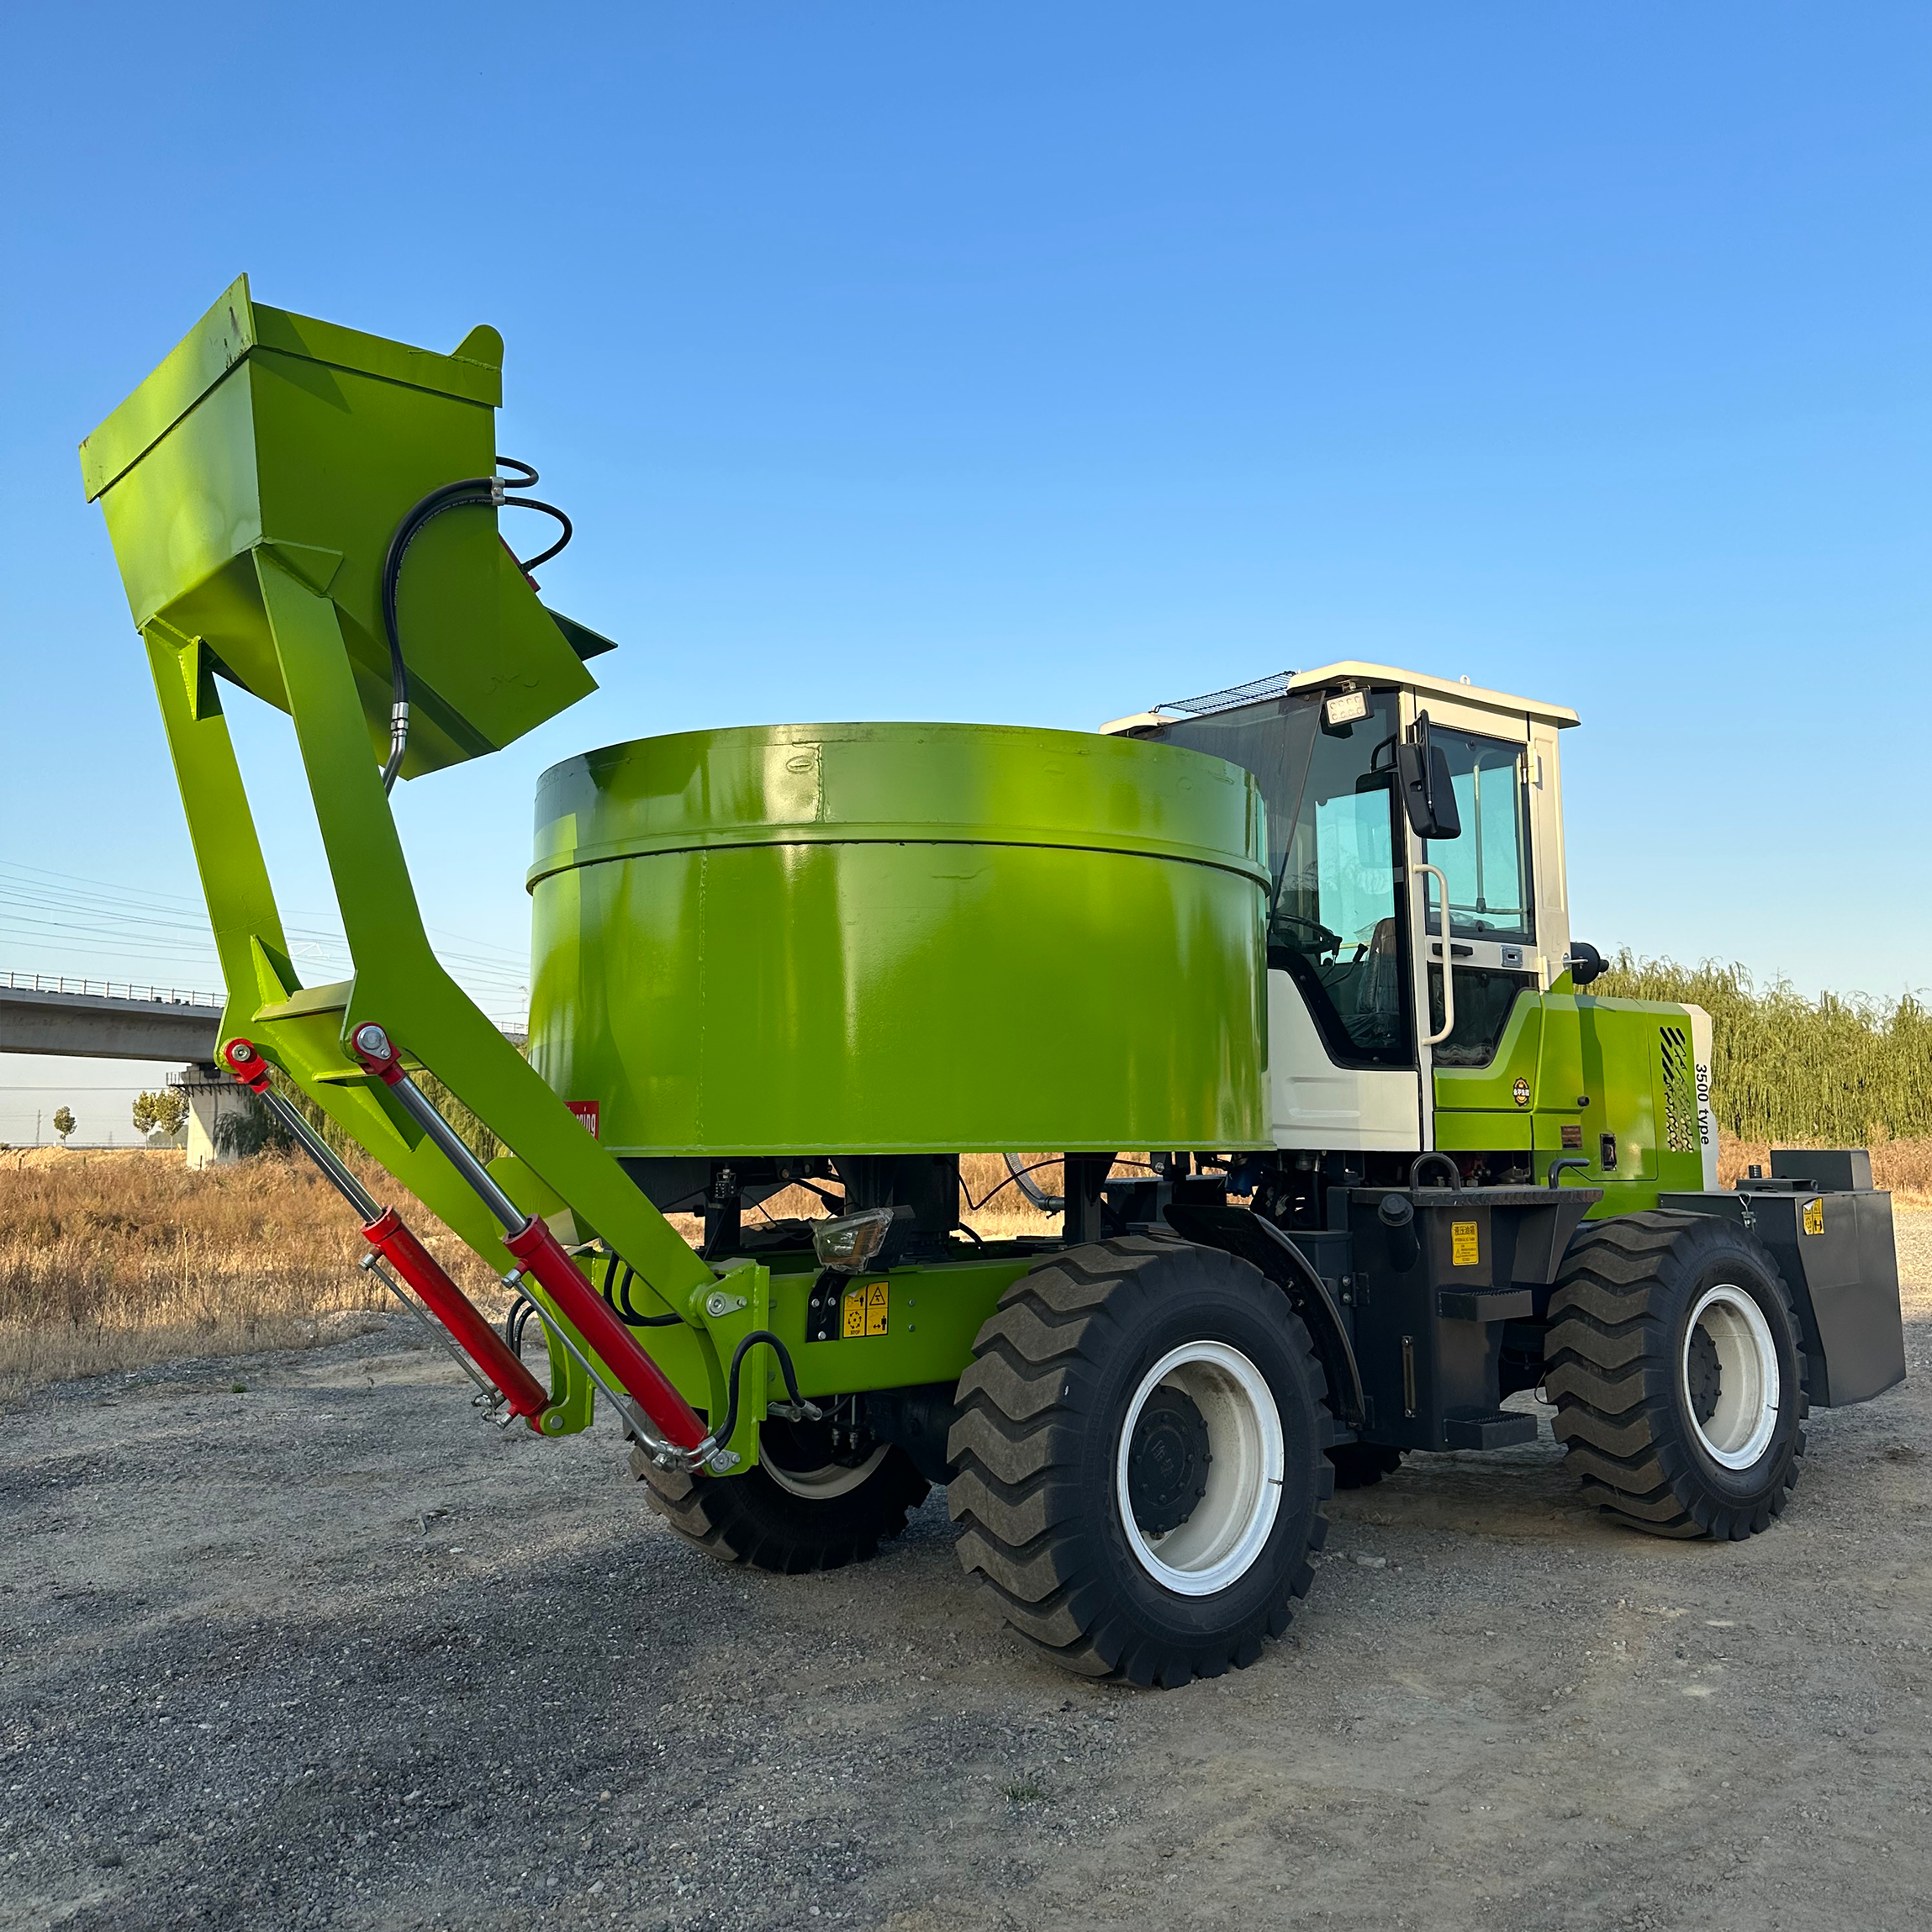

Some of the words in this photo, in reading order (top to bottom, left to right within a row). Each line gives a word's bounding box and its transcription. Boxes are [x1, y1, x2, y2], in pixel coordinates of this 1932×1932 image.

[1696, 1064, 1708, 1102] 3500
[1697, 1108, 1709, 1145] type
[1454, 1225, 1475, 1236] 液压油箱
